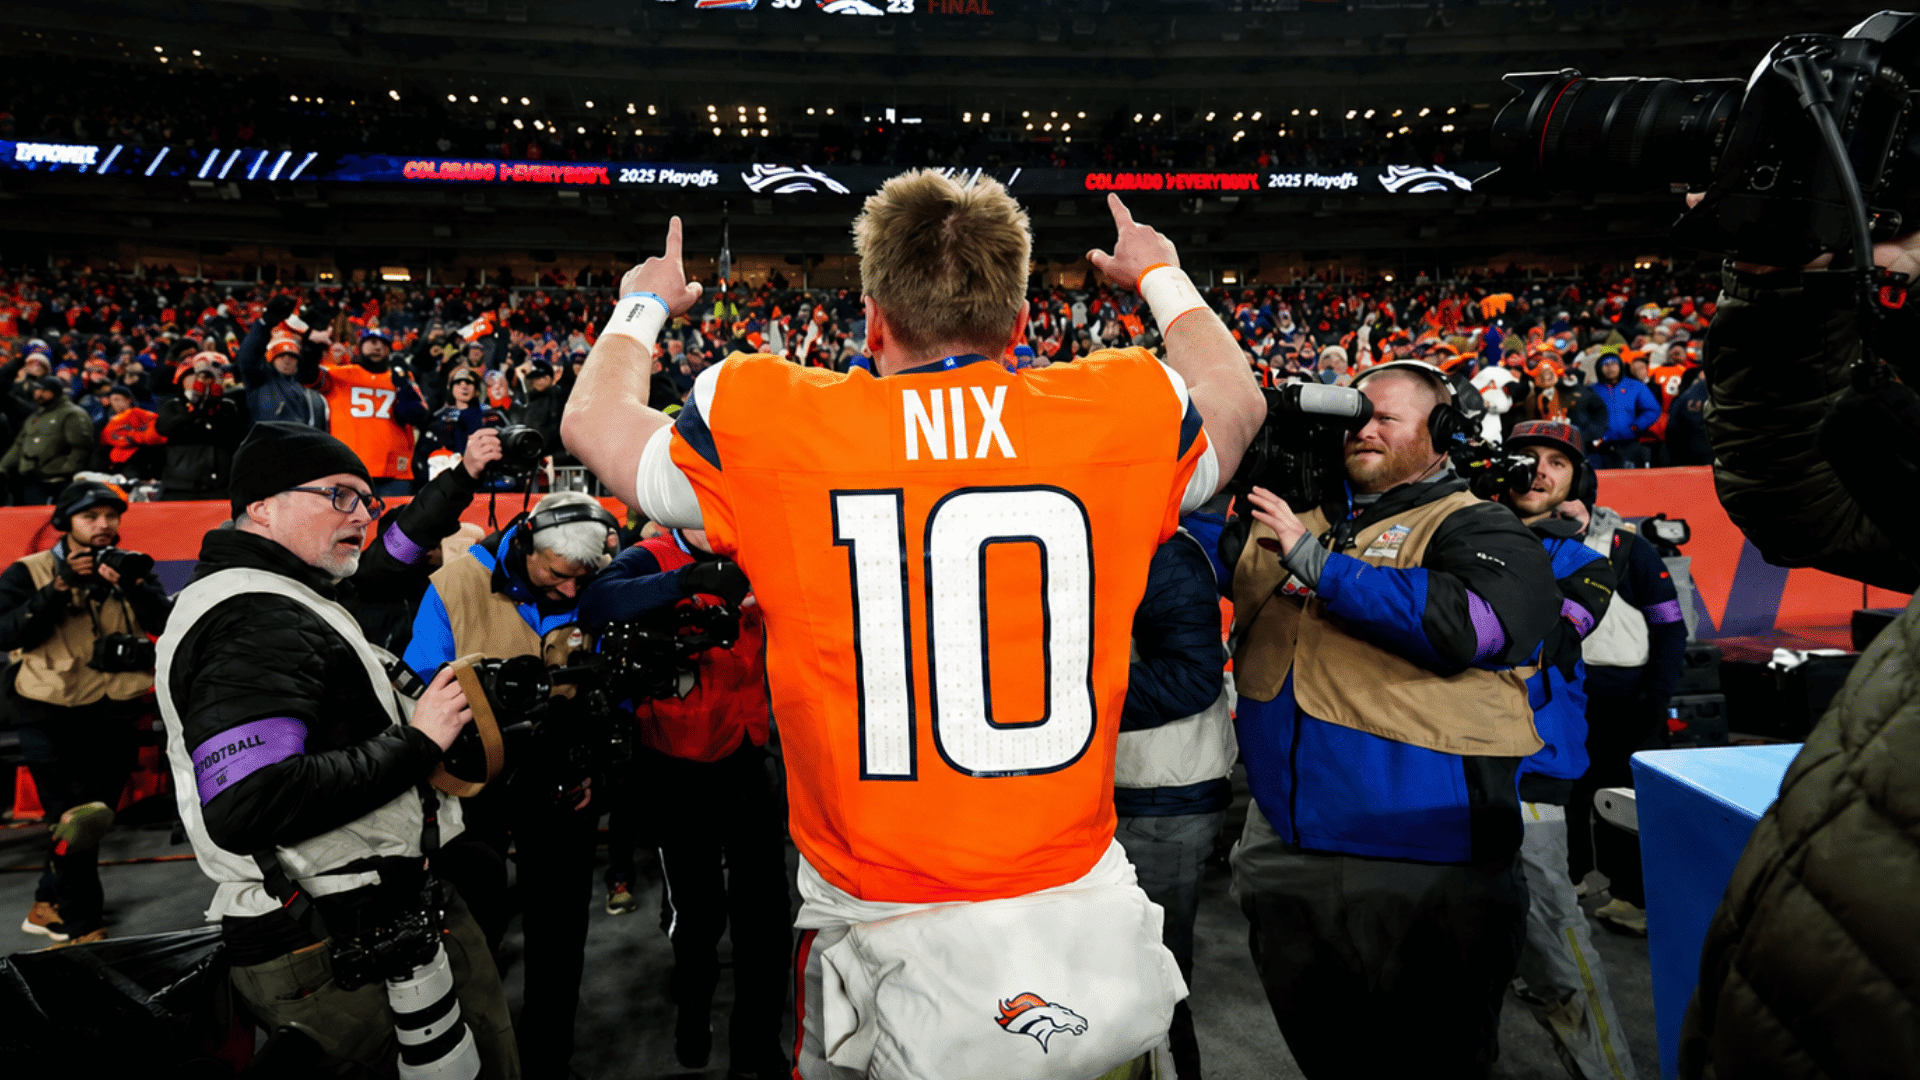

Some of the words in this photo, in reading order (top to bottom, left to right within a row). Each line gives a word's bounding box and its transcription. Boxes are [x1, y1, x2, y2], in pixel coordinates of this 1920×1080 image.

[887, 0, 915, 14] 23
[928, 0, 994, 16] FINAL
[403, 160, 496, 182] COLORADO
[619, 168, 656, 184] 2025
[658, 168, 719, 188] Playoffs
[1085, 172, 1163, 190] COLORADO
[1268, 173, 1302, 188] 2025
[1304, 172, 1359, 190] Playoffs
[350, 387, 395, 419] 57
[902, 385, 1017, 461] NIX
[829, 485, 1097, 781] 10
